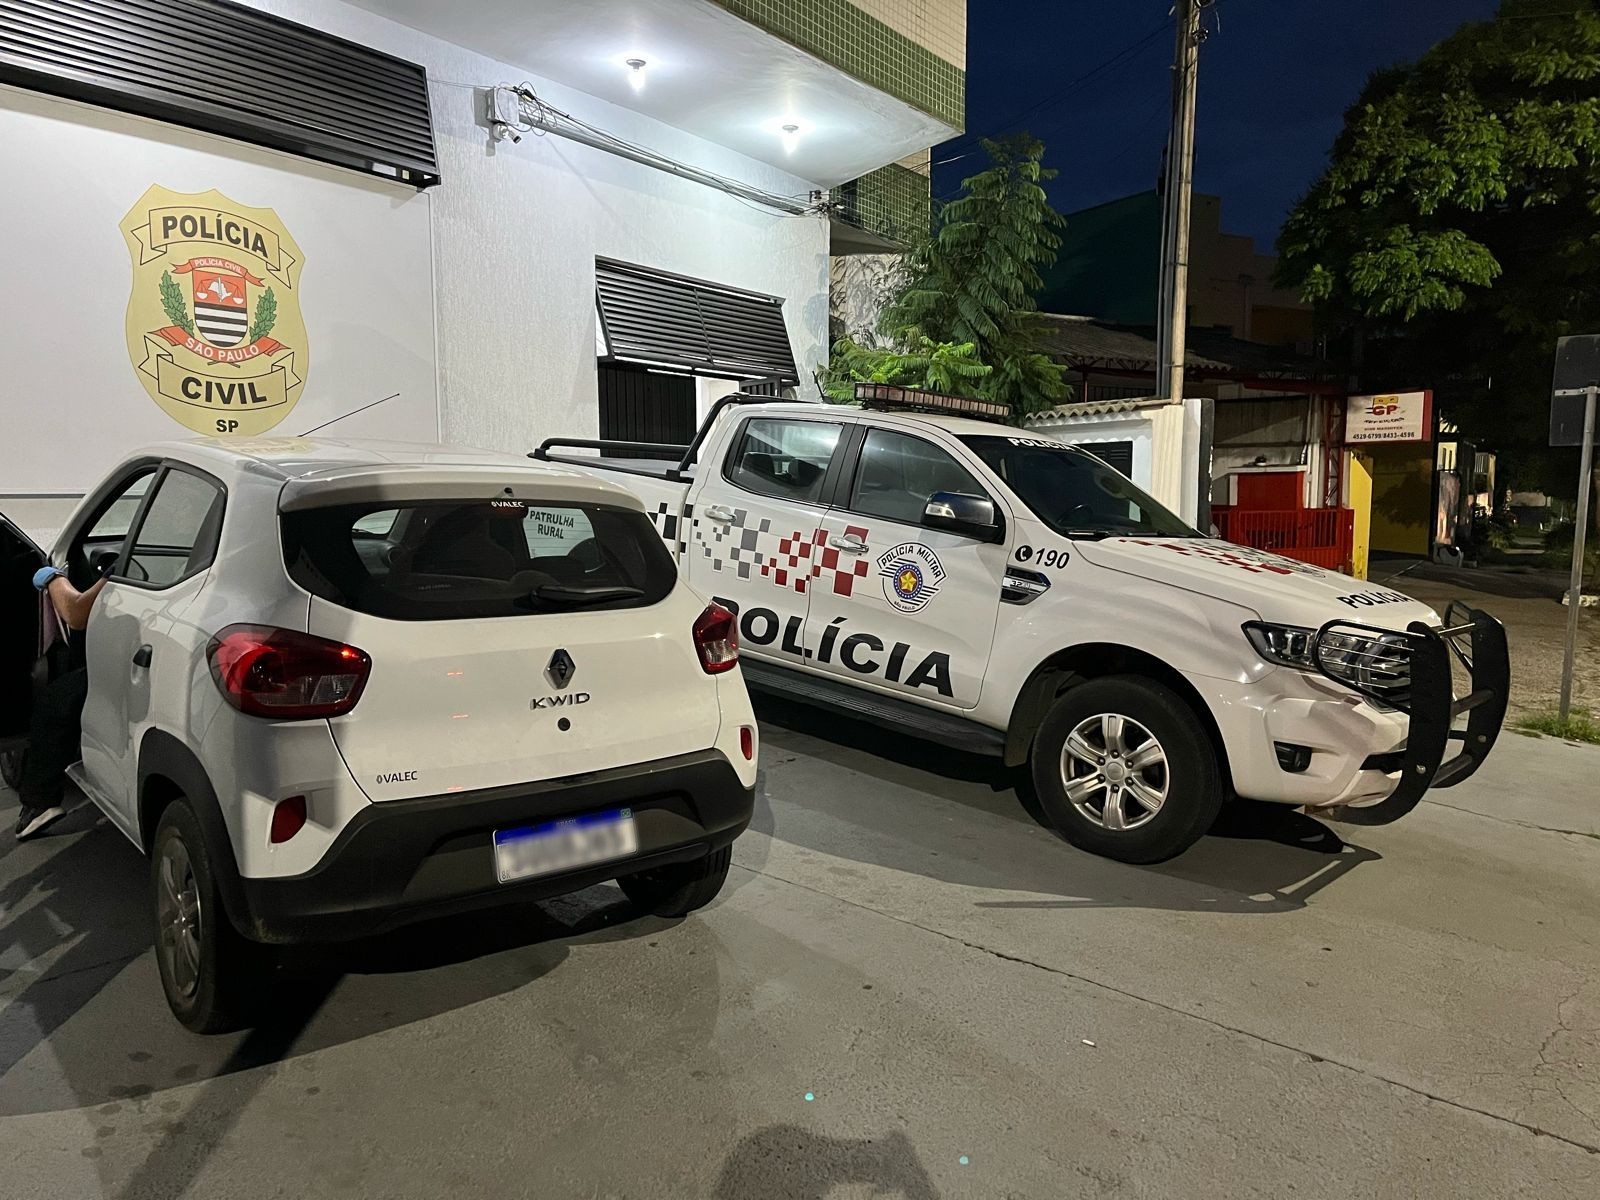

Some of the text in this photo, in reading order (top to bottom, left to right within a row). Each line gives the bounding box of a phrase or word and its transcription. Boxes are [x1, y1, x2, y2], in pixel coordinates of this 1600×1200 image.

[162, 213, 268, 258] POLÍCIA
[225, 262, 241, 272] CIVIL
[218, 345, 259, 361] PAULO
[181, 376, 267, 405] CIVIL
[1372, 405, 1398, 416] GP
[216, 419, 239, 433] SP
[529, 510, 574, 528] PATRULHA
[537, 523, 564, 539] RURAL
[916, 547, 942, 579] MILITAR
[1035, 547, 1070, 570] 190
[1336, 589, 1414, 609] POLÍCIA
[530, 692, 590, 710] KWID
